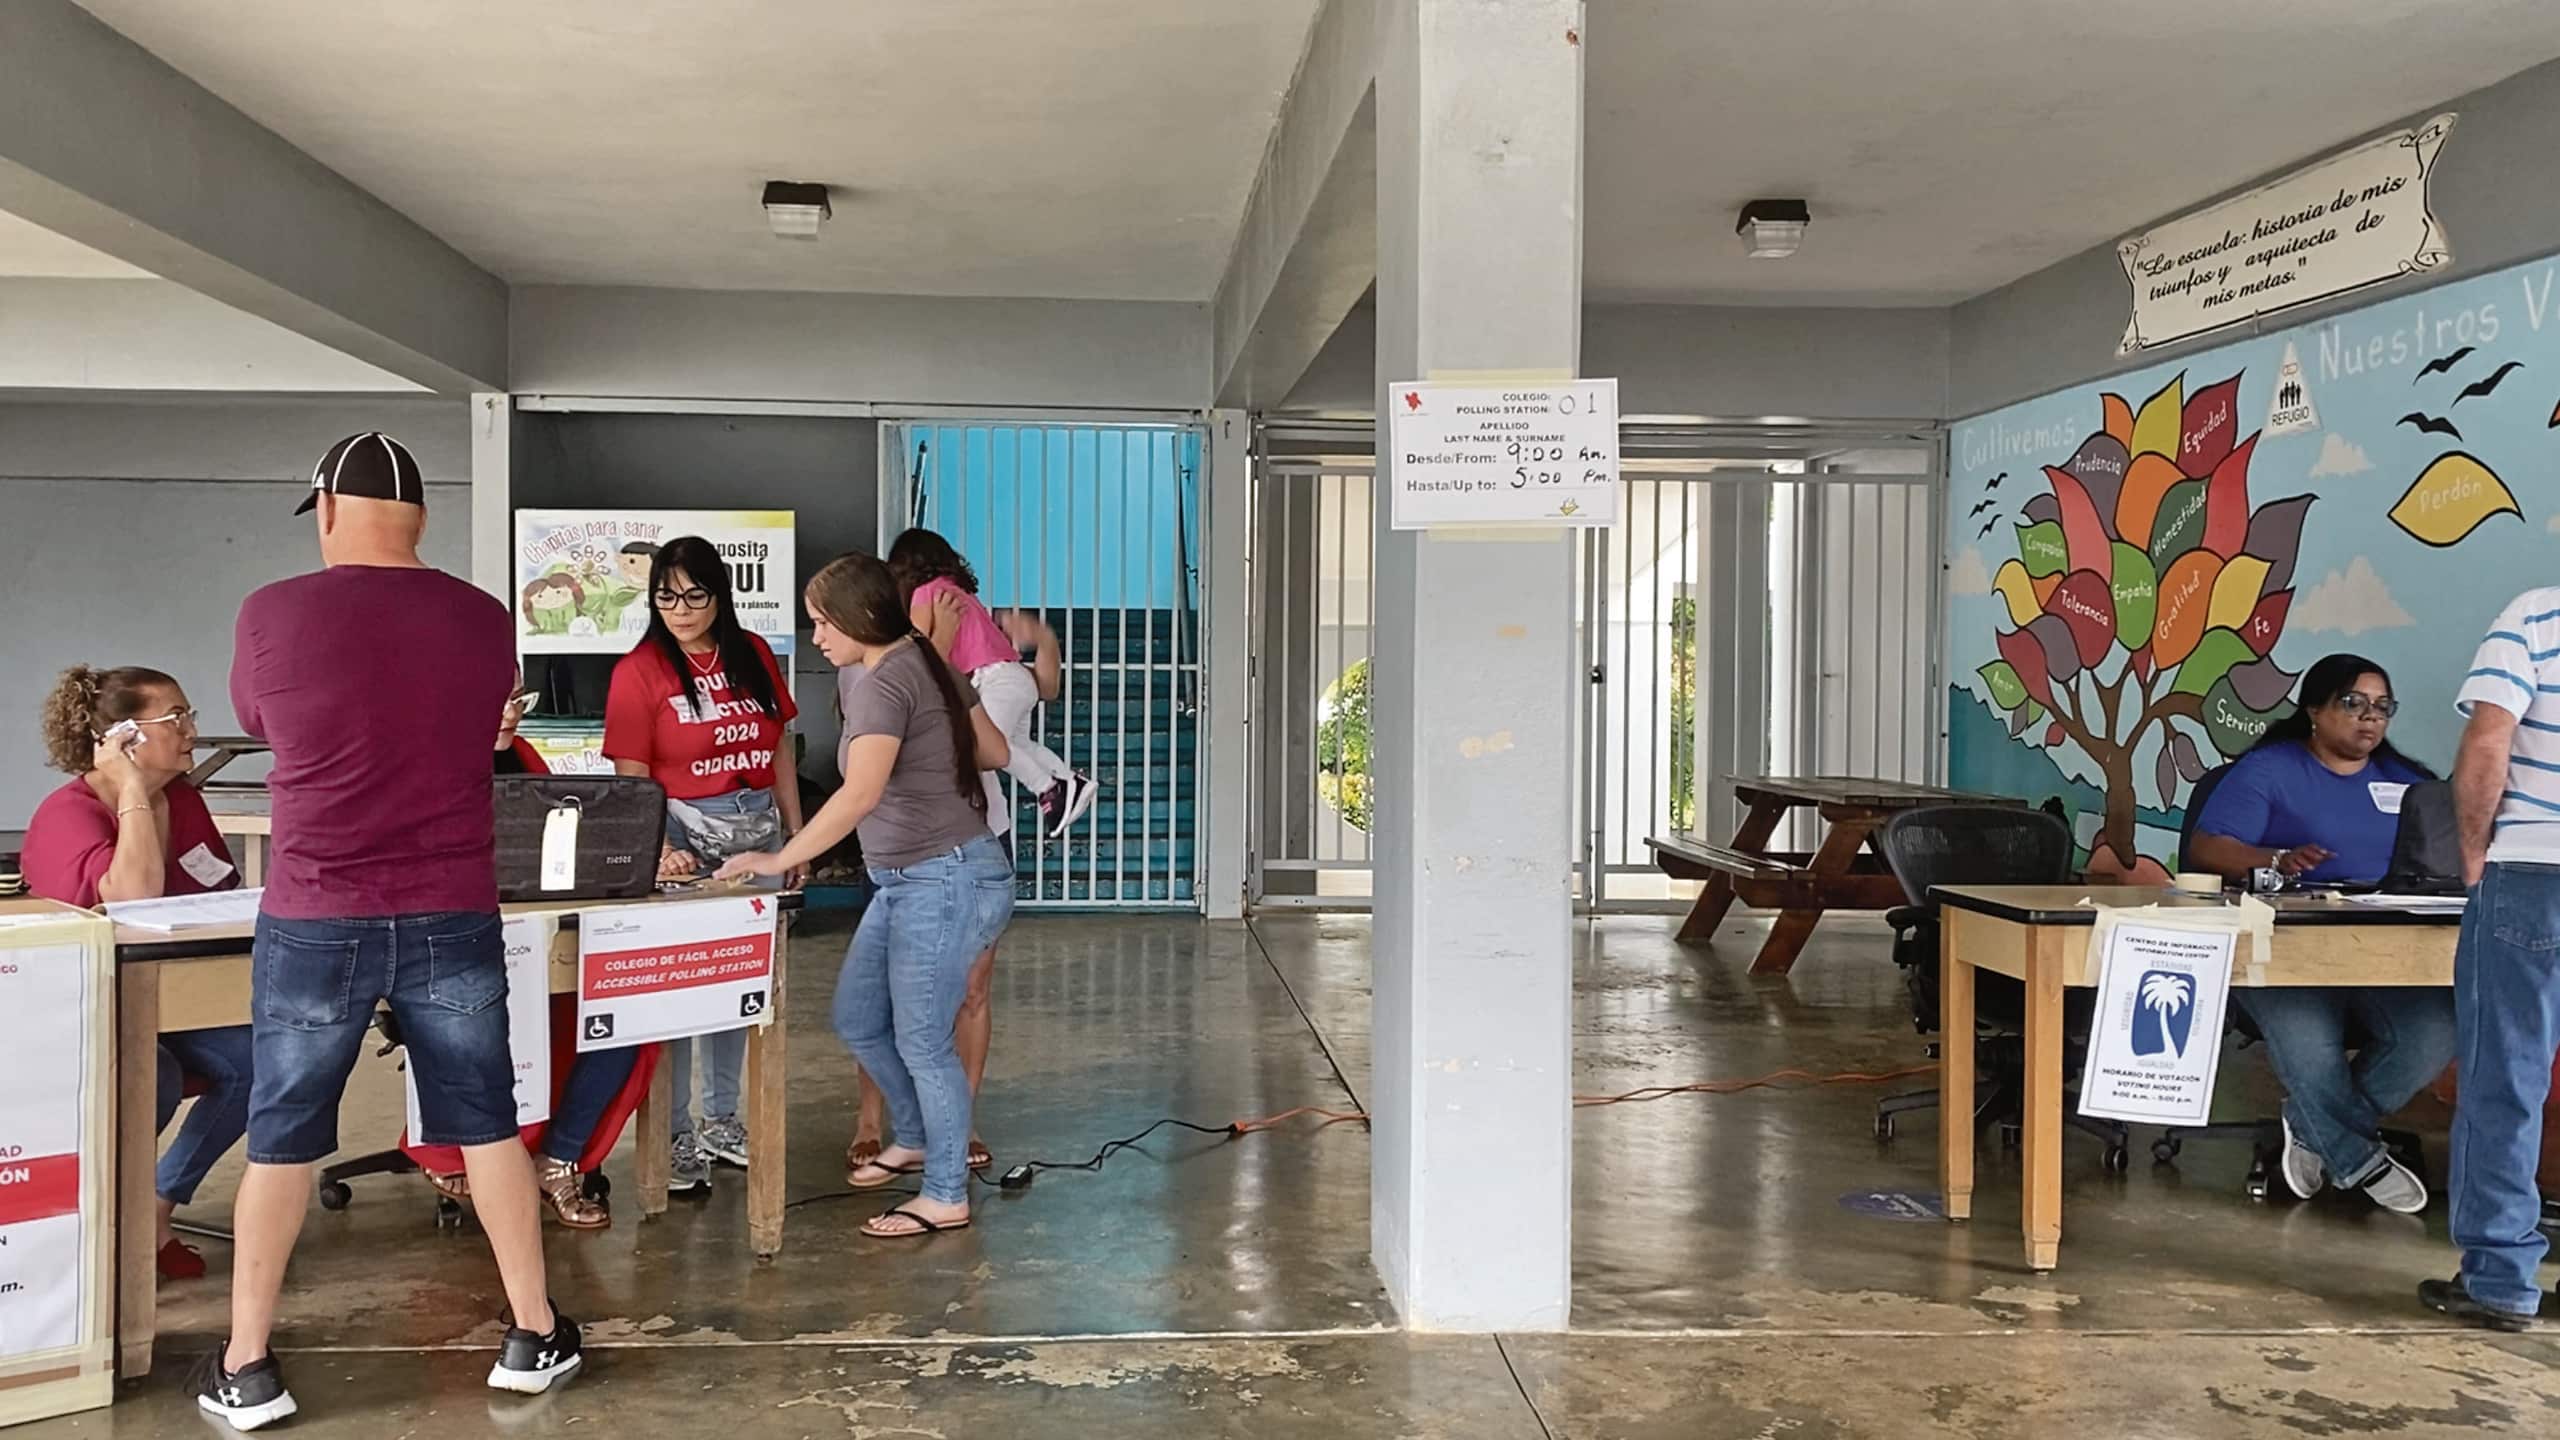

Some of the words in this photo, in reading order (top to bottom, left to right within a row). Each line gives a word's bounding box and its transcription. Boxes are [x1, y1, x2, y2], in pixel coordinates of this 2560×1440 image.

[2177, 230, 2247, 266] escuela:
[2252, 205, 2328, 240] historia
[2330, 188, 2358, 212] de
[2360, 176, 2408, 202] mis
[2150, 268, 2216, 301] triunfos
[2218, 265, 2233, 285] y
[2245, 228, 2338, 267] arquitecta
[2355, 209, 2385, 232] de
[2203, 288, 2238, 309] mis
[2319, 303, 2499, 384] Nuestros
[1502, 392, 1552, 402] COLEGIO:
[1456, 406, 1501, 415] POLLING
[1503, 405, 1551, 414] STATION:
[2271, 406, 2310, 427] REFUGIO
[1479, 422, 1530, 430] APELLIDO
[2184, 400, 2228, 454] Equidad
[1444, 435, 1470, 443] LAST
[1516, 434, 1565, 443] SURNAME
[1962, 418, 2075, 471] Cultivemos
[1406, 452, 1497, 465] Desde/From:
[1507, 442, 1563, 465] 9:00
[2075, 453, 2122, 476] Prudencia
[1406, 479, 1473, 493] Hasta/Up
[1477, 479, 1497, 491] to:
[2420, 475, 2482, 515] Perdón
[524, 526, 581, 565] Chapitas
[585, 520, 617, 542] para
[624, 521, 664, 539] sanar
[717, 541, 769, 557] posita
[2061, 588, 2109, 627] Tolerancia
[2159, 569, 2201, 640] Gratitud
[2254, 616, 2271, 638] Fe
[2216, 698, 2267, 736] Servicio
[714, 722, 760, 746] 2024
[690, 752, 751, 777] CIDRA
[750, 749, 775, 770] PP
[2125, 936, 2157, 946] CENTRO
[2170, 941, 2219, 951] INFORMACIÓN
[2133, 947, 2184, 957] INFORMATION
[604, 954, 658, 972] COLEGIO
[659, 953, 676, 967] DE
[677, 948, 710, 964] FÁCIL
[711, 944, 755, 960] ACCESO
[593, 972, 668, 990] ACCESSIBLE
[668, 964, 717, 981] POLLING
[717, 958, 766, 975] STATION
[2102, 1067, 2143, 1078] HORARIO
[2159, 1074, 2201, 1082] VOTACIÓN
[2117, 1081, 2151, 1089] VOTING
[2152, 1084, 2182, 1092] HOURS
